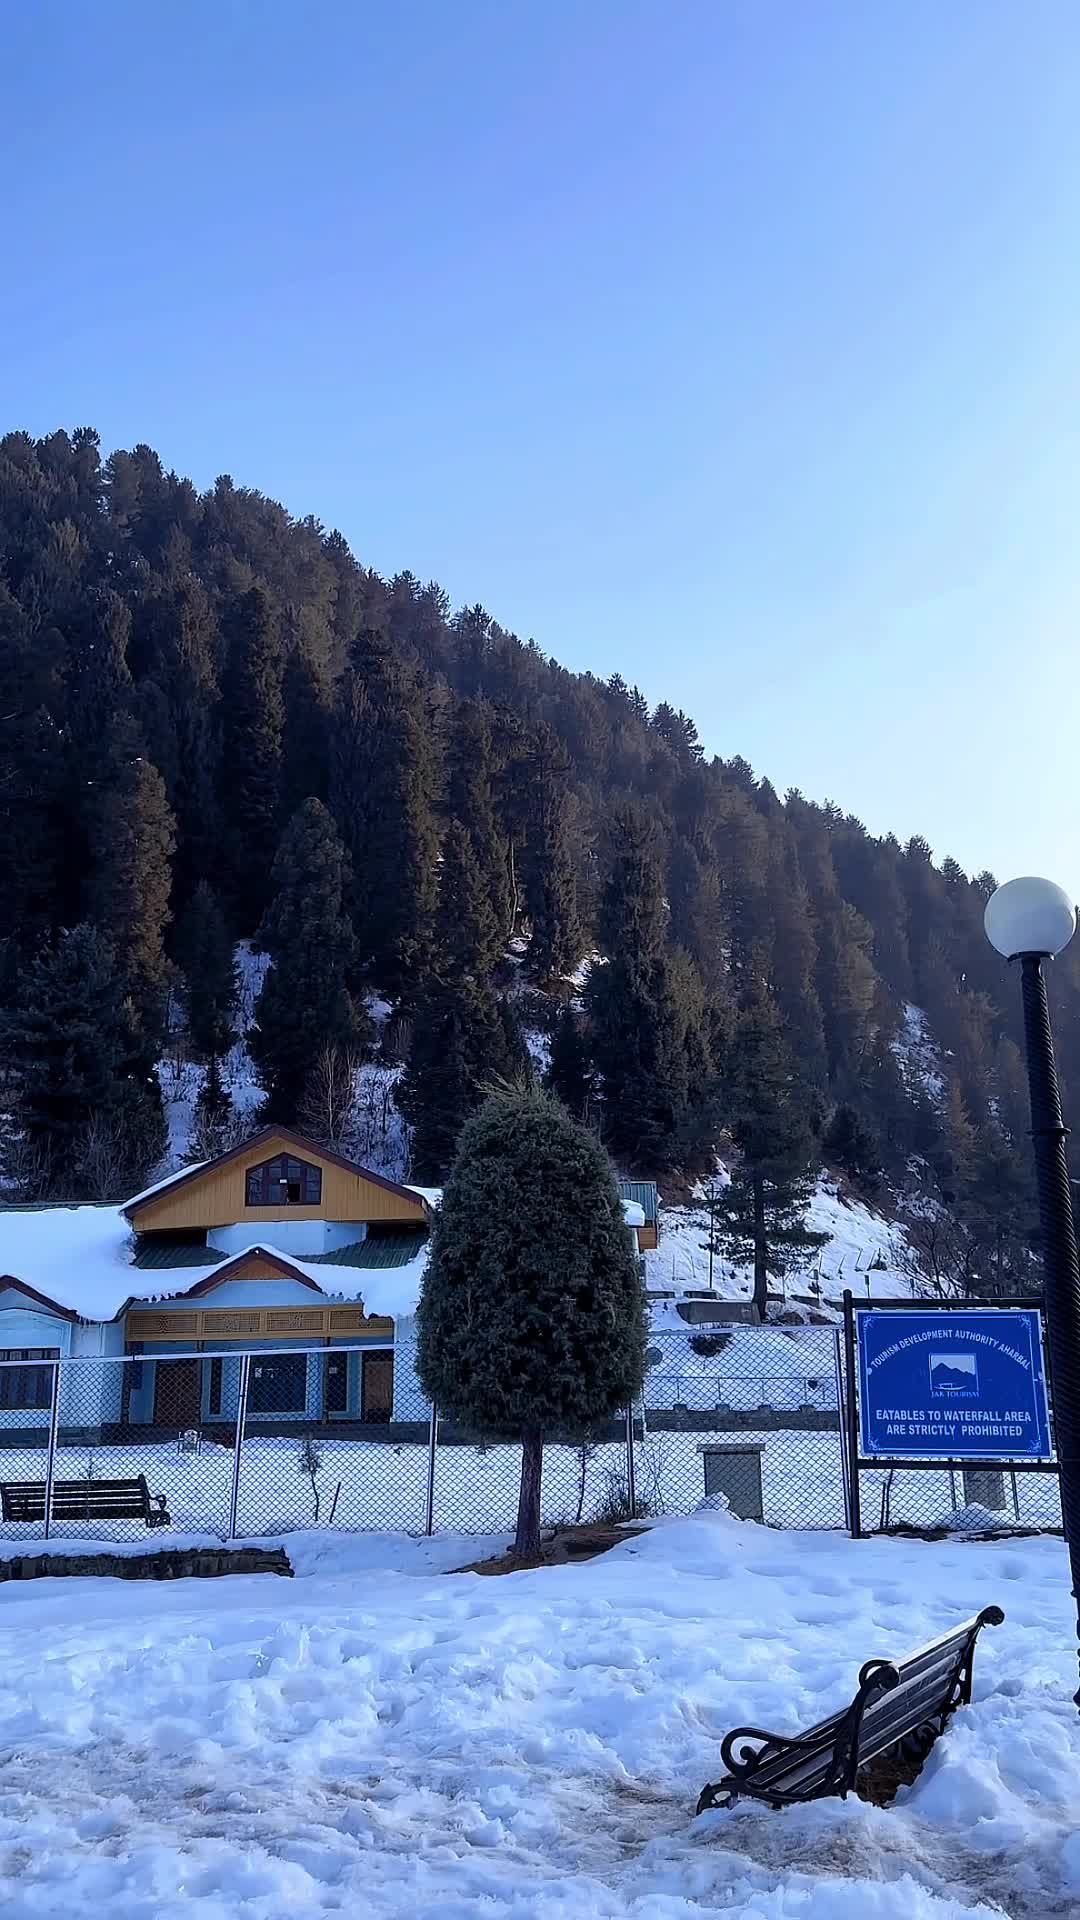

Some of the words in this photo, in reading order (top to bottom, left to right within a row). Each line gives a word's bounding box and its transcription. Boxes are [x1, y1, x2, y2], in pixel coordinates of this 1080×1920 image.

[870, 1343, 901, 1368] TOURISM
[900, 1329, 953, 1349] DEVELOPMENT
[954, 1329, 1000, 1348] AUTHORITY
[997, 1343, 1031, 1370] AHARBAL
[876, 1409, 925, 1420] EATABLES
[927, 1410, 941, 1421] TO
[943, 1410, 1002, 1421] WATERFALL
[1004, 1411, 1032, 1422] AREA
[886, 1424, 906, 1435] ARE
[908, 1424, 956, 1436] STRICTLY
[961, 1425, 1023, 1437] PROHIBITED
